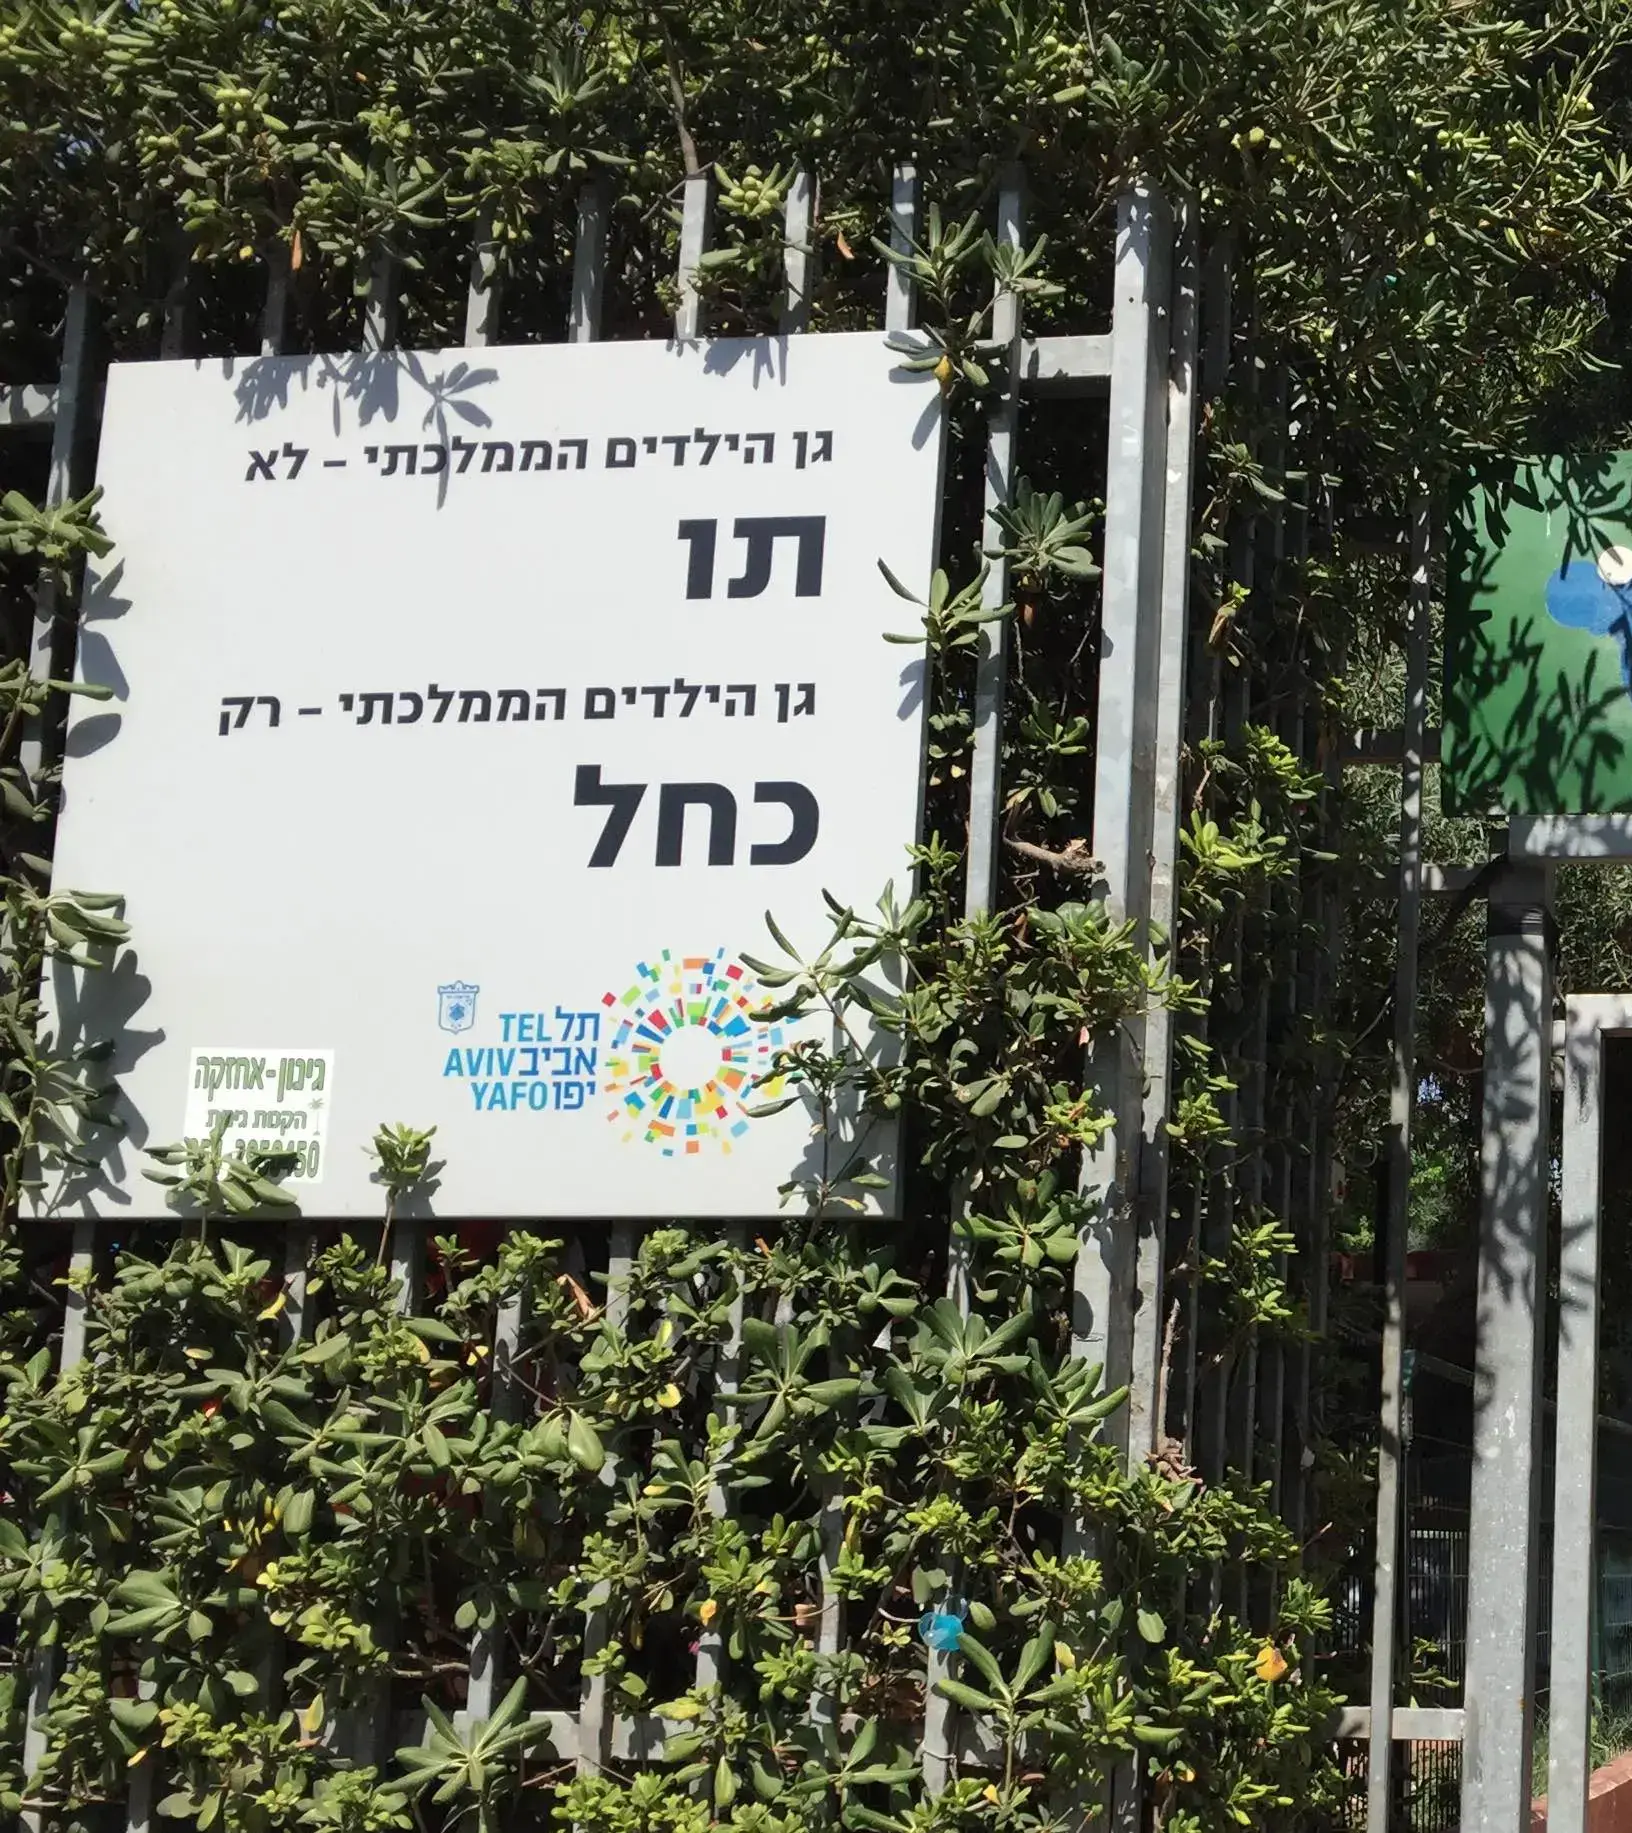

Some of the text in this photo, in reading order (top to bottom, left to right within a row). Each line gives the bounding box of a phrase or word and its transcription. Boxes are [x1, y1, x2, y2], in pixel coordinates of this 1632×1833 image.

[245, 442, 309, 481] לא
[364, 436, 588, 476] הממלכתי
[605, 428, 775, 469] הילדים
[793, 431, 833, 469] גן
[677, 515, 826, 600] תו
[219, 696, 281, 736] רק
[339, 683, 566, 725] הממלכתי
[584, 678, 757, 720] הילדים
[774, 683, 816, 723] גן
[573, 764, 820, 868] כחל
[498, 1013, 553, 1043] TEL
[554, 1005, 601, 1042] תל
[443, 1047, 516, 1077] AVIV
[518, 1046, 598, 1076] אביב
[470, 1081, 548, 1111] YAFO
[552, 1080, 596, 1111] יפו
[205, 1109, 248, 1130] גית
